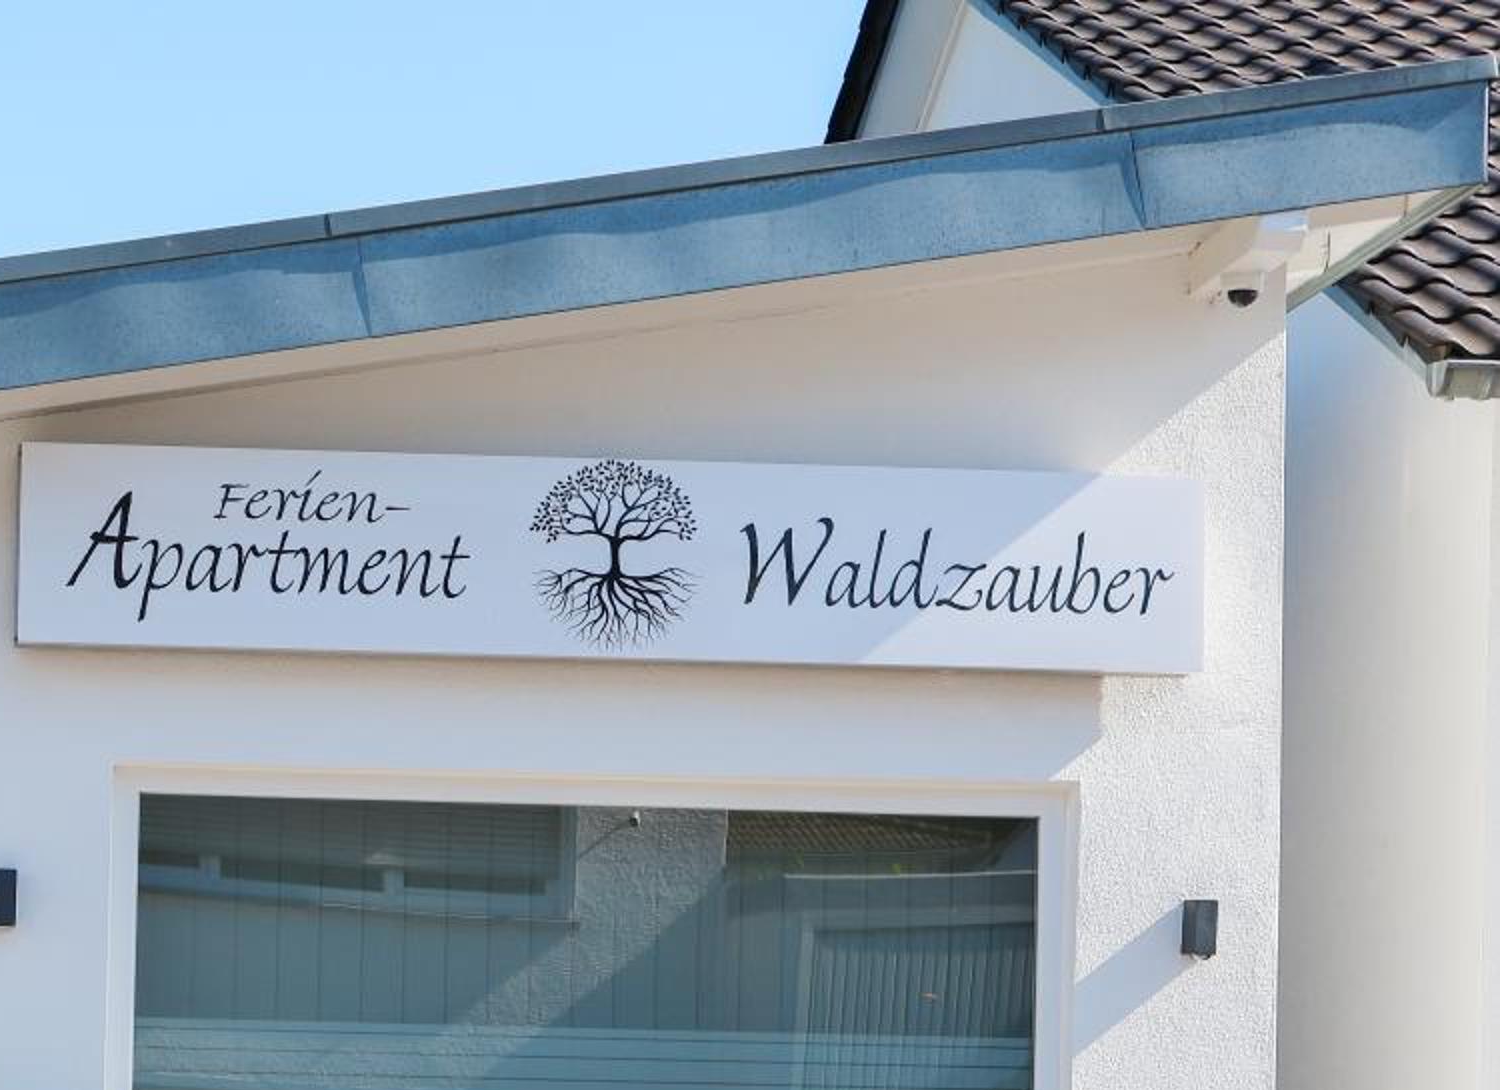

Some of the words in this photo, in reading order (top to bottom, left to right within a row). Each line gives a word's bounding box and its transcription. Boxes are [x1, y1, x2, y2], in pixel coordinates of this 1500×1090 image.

[213, 469, 409, 524] Ferien-
[65, 490, 471, 623] Apartment
[739, 517, 1172, 615] Waldzauber
